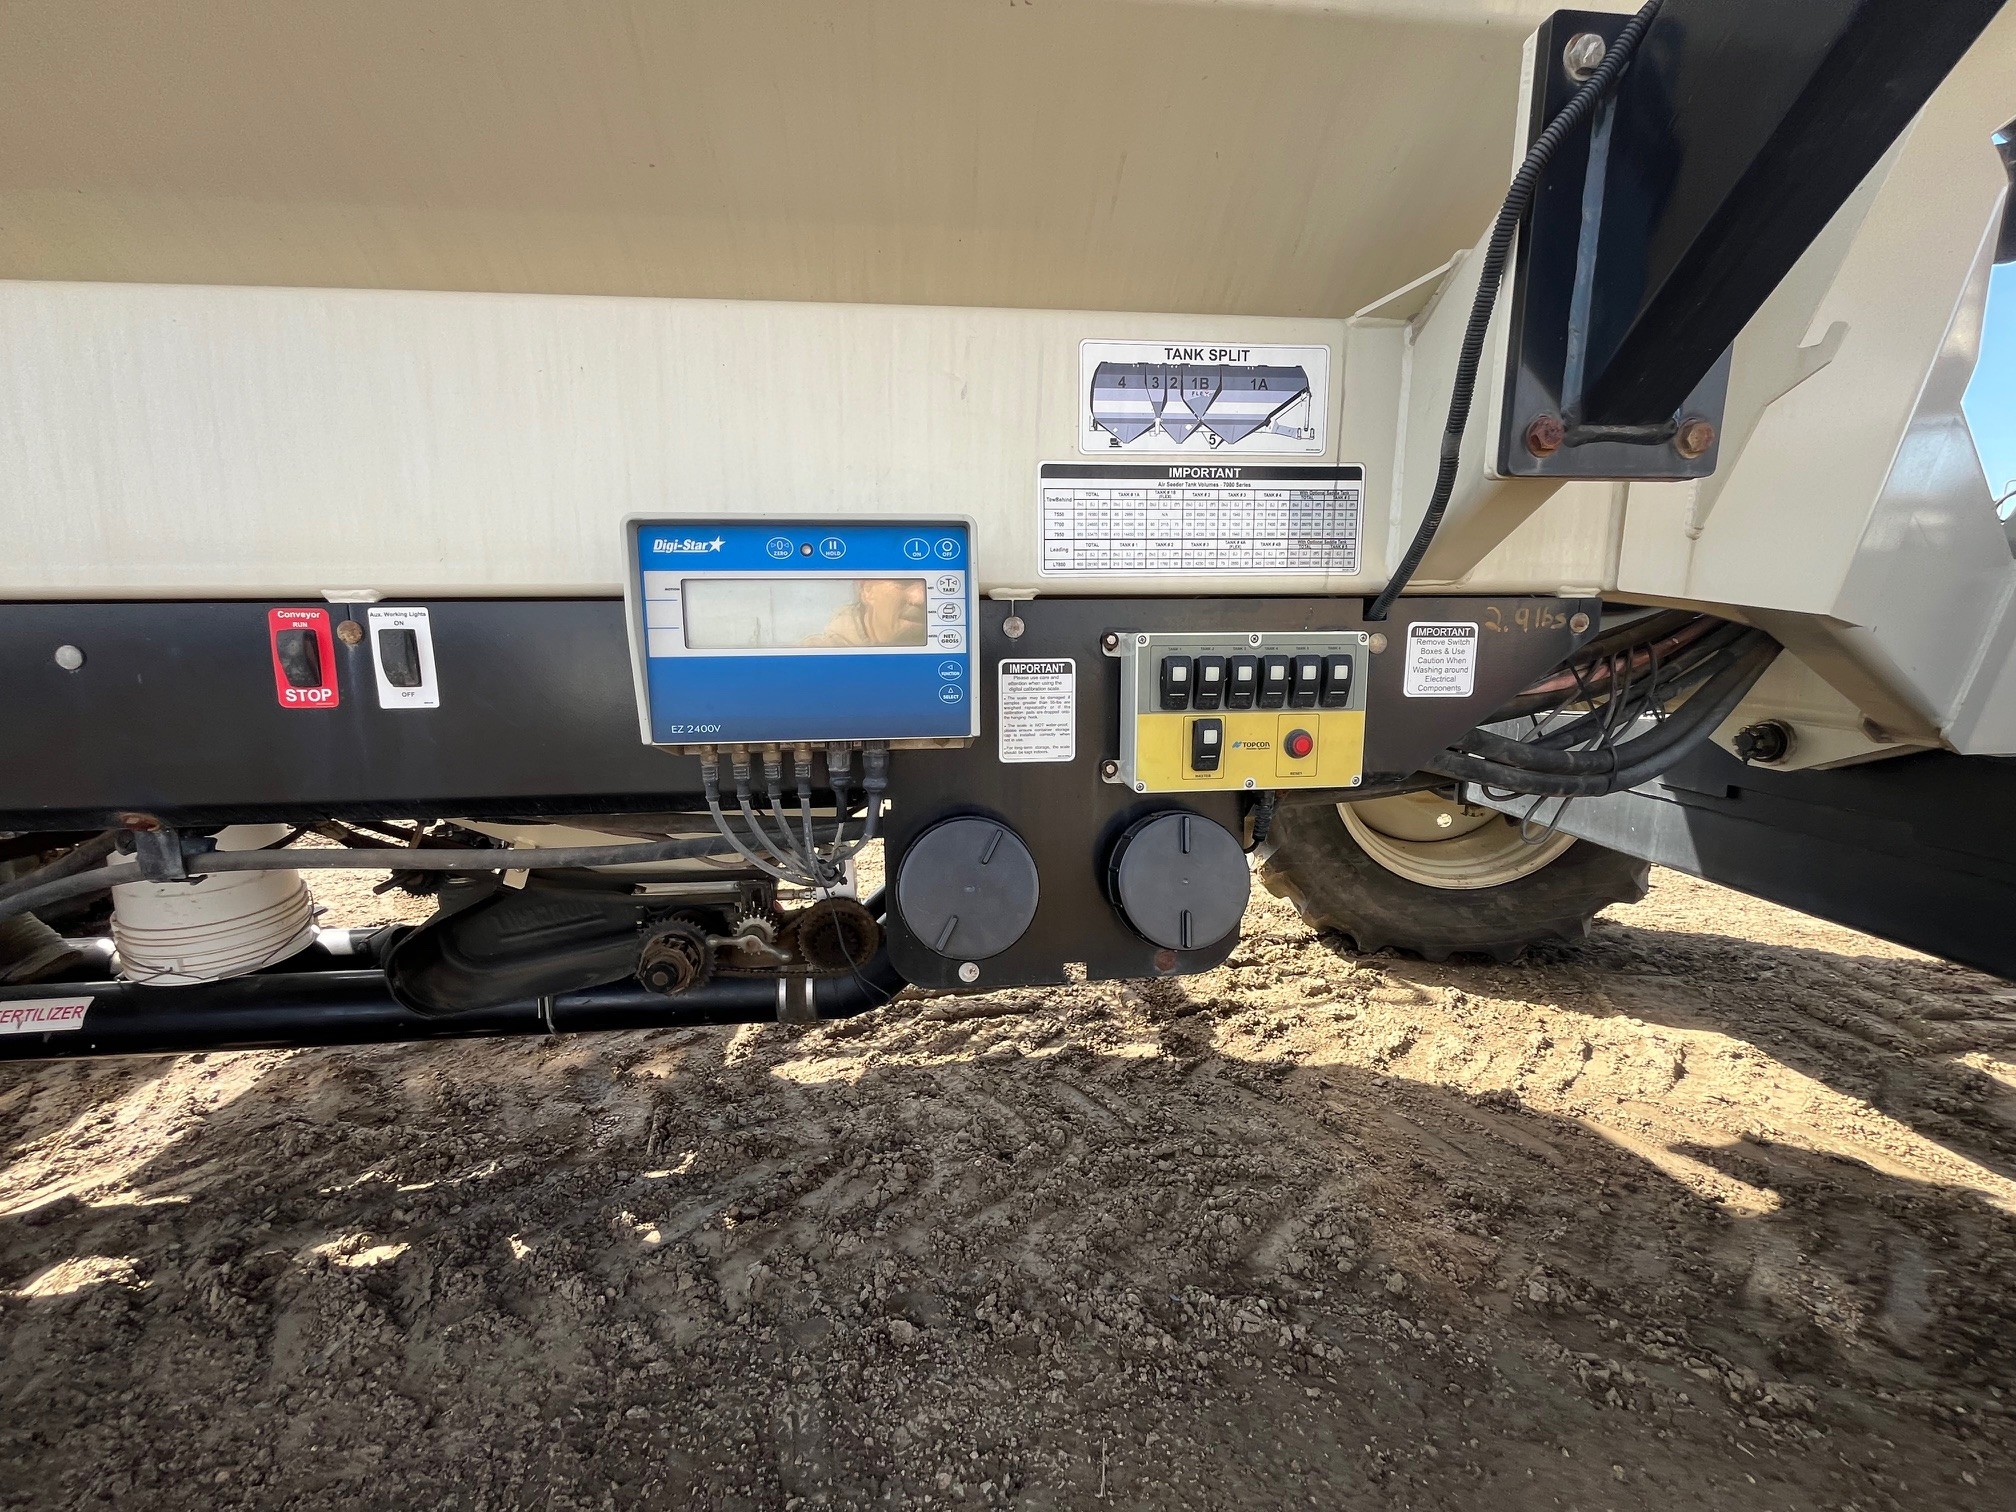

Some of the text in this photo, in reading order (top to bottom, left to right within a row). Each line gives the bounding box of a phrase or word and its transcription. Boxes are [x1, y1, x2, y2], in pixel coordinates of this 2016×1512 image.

[1164, 348, 1250, 362] TANK SPLIT
[1118, 377, 1268, 390] 4 3 2 1B 1A
[1209, 434, 1216, 445] 5
[1169, 467, 1241, 478] IMPORTANT
[653, 539, 709, 553] Digi-Star
[277, 611, 320, 619] Conveyor
[1416, 628, 1471, 636] IMPORTANT
[1009, 664, 1065, 673] IMPORTANT
[1412, 666, 1442, 674] Washing
[286, 688, 332, 702] STOP
[672, 724, 721, 733] EZ 2400V
